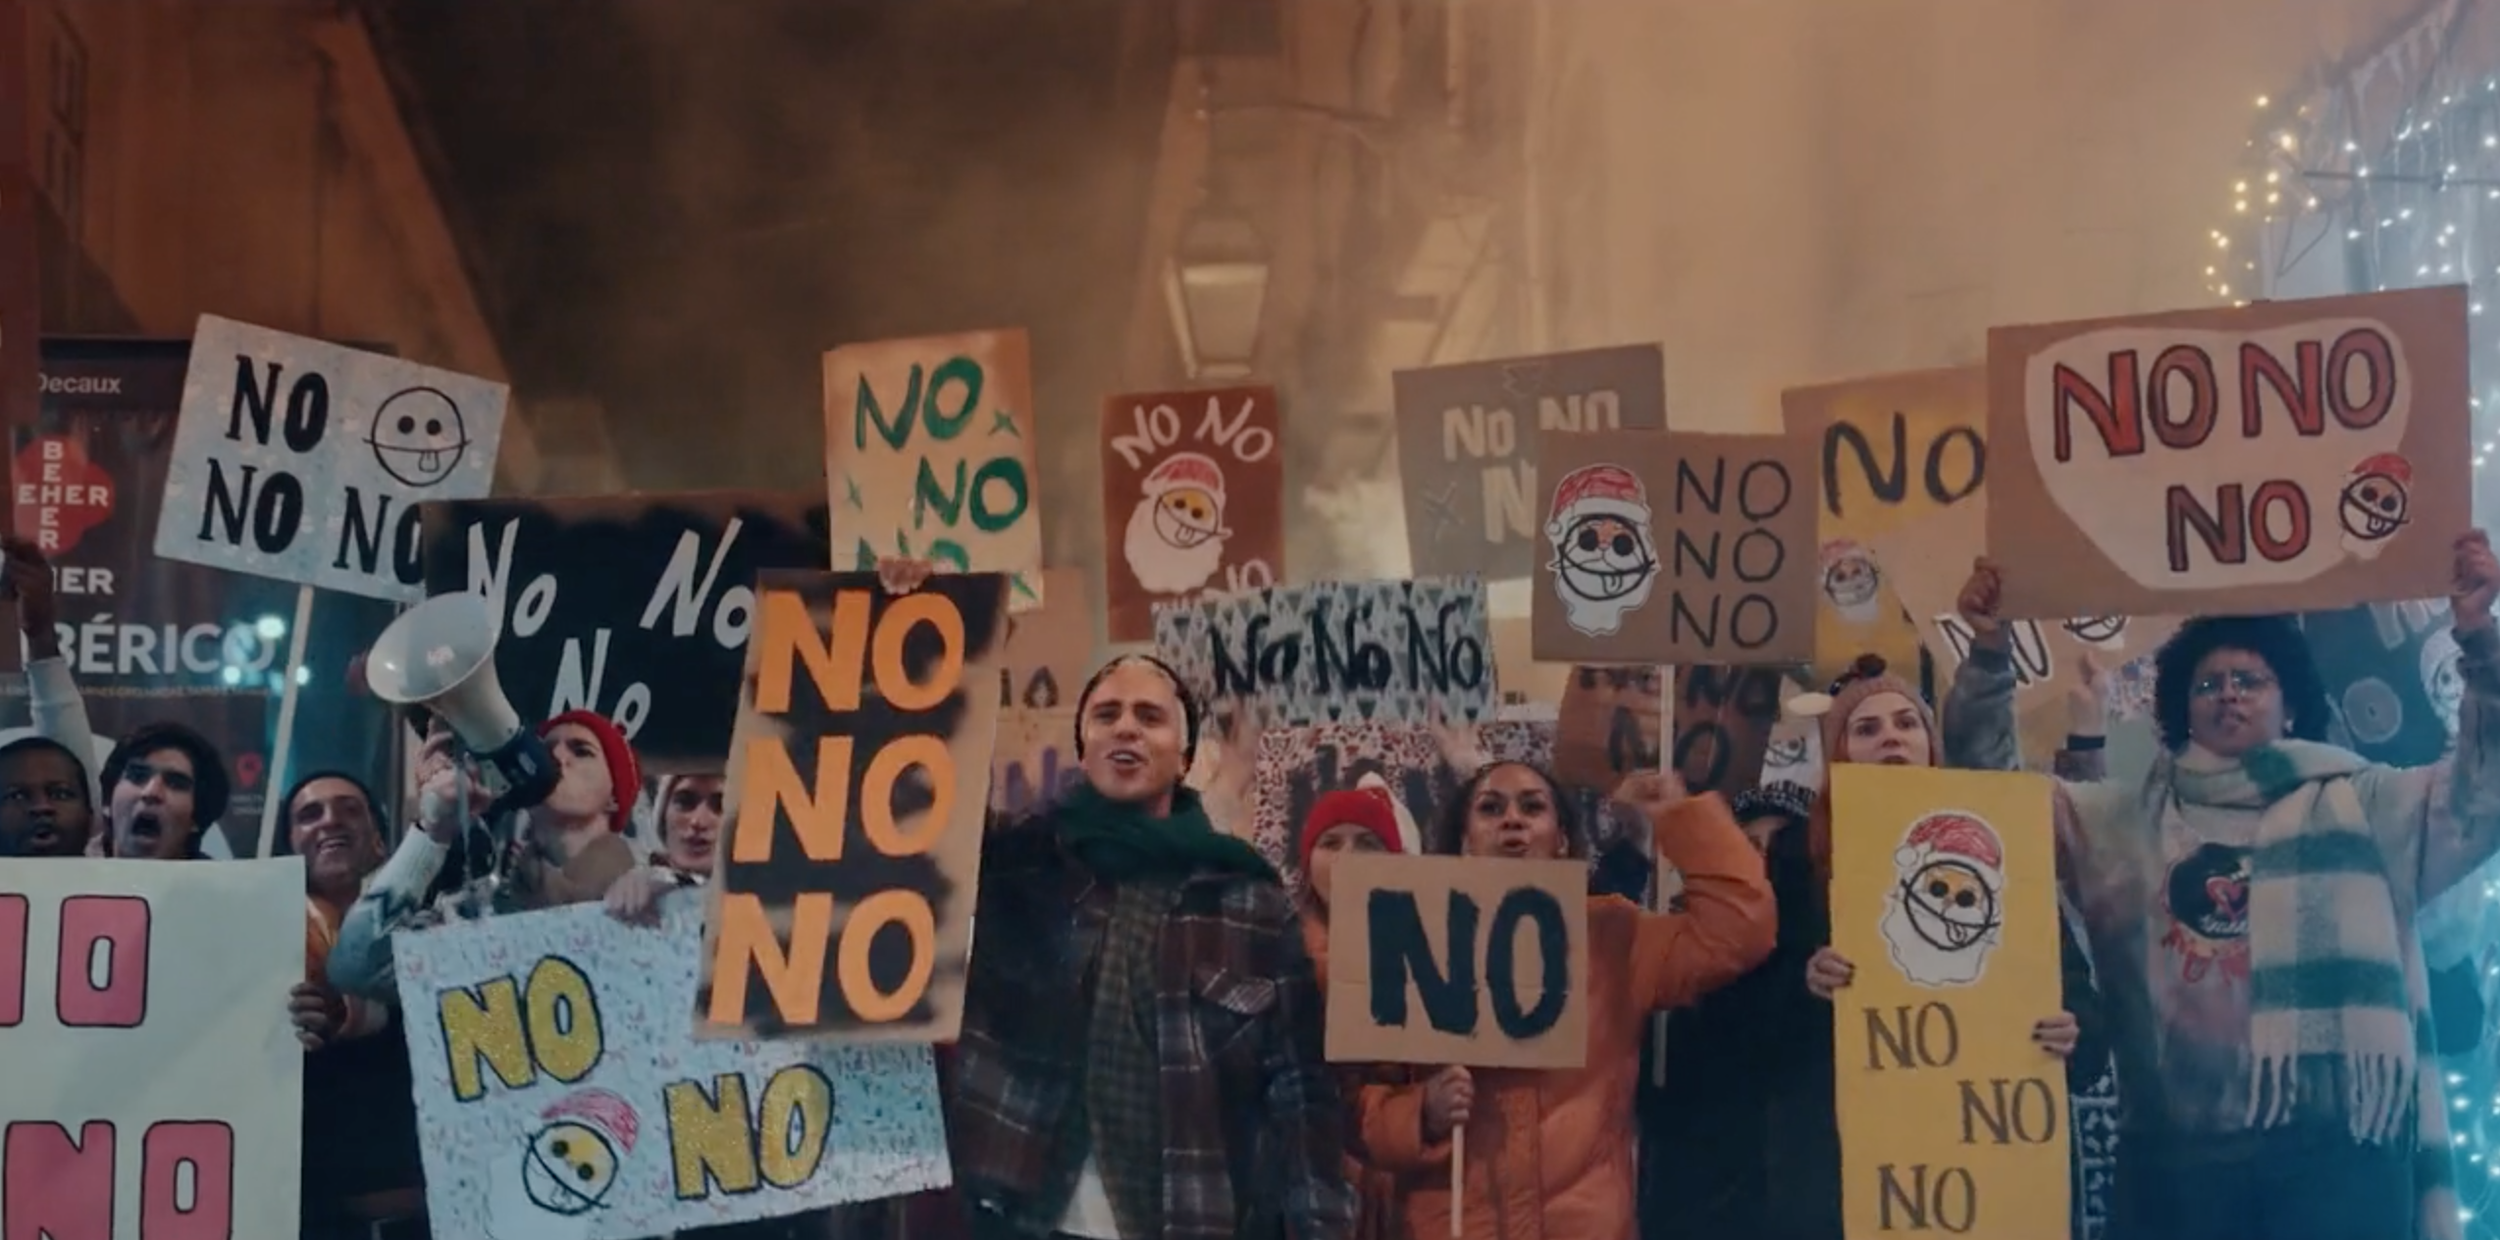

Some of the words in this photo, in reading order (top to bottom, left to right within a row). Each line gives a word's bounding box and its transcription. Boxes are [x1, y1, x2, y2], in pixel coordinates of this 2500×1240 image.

[225, 354, 329, 453] NO
[855, 356, 983, 450] NO
[1111, 404, 1180, 469] NO
[1194, 397, 1273, 462] NO
[1539, 390, 1619, 432] NO
[2054, 344, 2218, 462] NO
[2240, 327, 2396, 437] NO
[197, 458, 304, 554] NO
[333, 486, 424, 585] NO
[915, 456, 1028, 531] NO
[1675, 456, 1791, 521] NO
[2167, 480, 2310, 572] NO
[52, 567, 114, 595] ER
[1674, 527, 1785, 583] NO
[755, 590, 964, 713] NO
[1671, 590, 1778, 649] NO
[733, 734, 956, 863] NO
[0, 894, 151, 1028] O
[708, 889, 935, 1025] NO
[1368, 884, 1569, 1040] NO
[438, 955, 603, 1101] NO
[1862, 1002, 1958, 1070] NO
[663, 1065, 834, 1201] NO
[1957, 1078, 2056, 1145] NO
[3, 1120, 233, 1240] NO
[1877, 1164, 1976, 1233] NO
